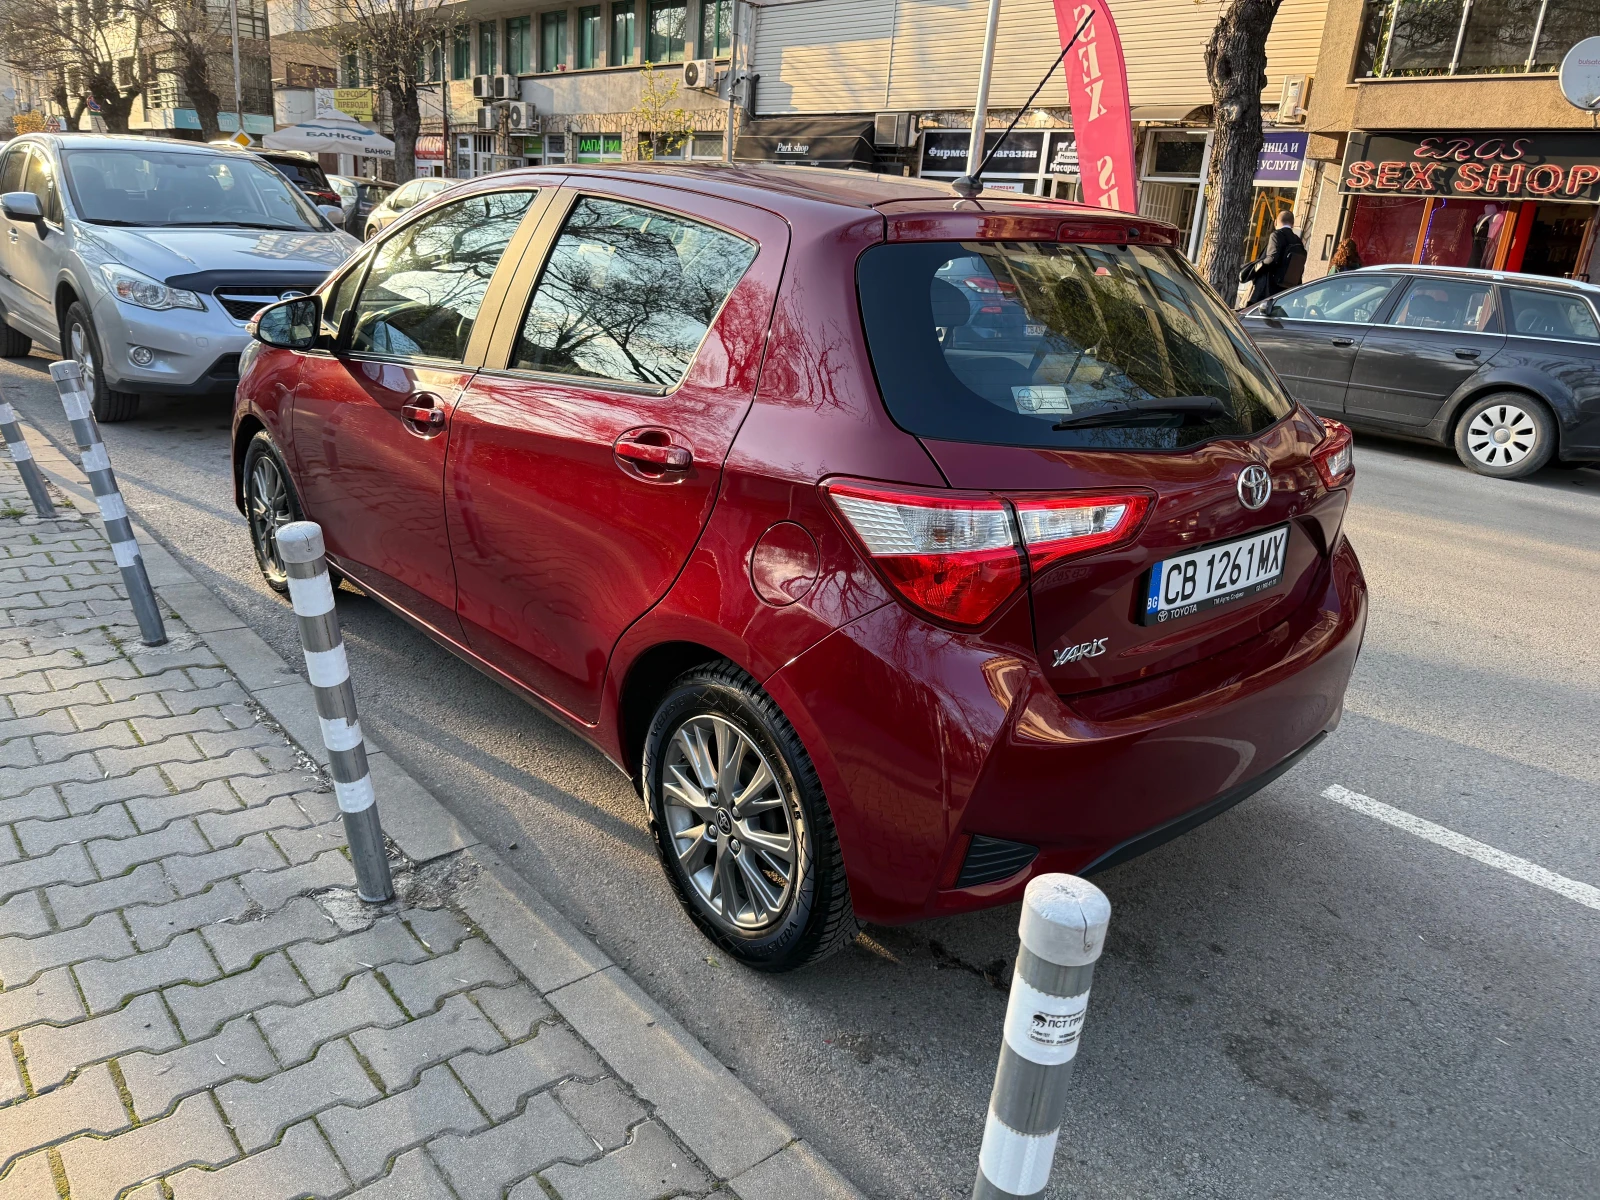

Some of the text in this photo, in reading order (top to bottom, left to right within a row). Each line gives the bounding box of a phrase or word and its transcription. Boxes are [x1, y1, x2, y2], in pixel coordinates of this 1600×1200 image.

[337, 101, 369, 109] ПРЕВОДИ
[306, 131, 363, 141] БАНКЯ
[364, 147, 392, 156] БАНКЯ
[776, 142, 809, 154] Park shop
[1260, 160, 1299, 171] УСЛУГИ
[1346, 161, 1600, 195] SEX SHOP
[1164, 532, 1285, 606] CB 1261 MX
[1147, 596, 1159, 610] BG
[1170, 604, 1198, 619] TOYOTA
[1047, 1019, 1067, 1029] ПСТ
